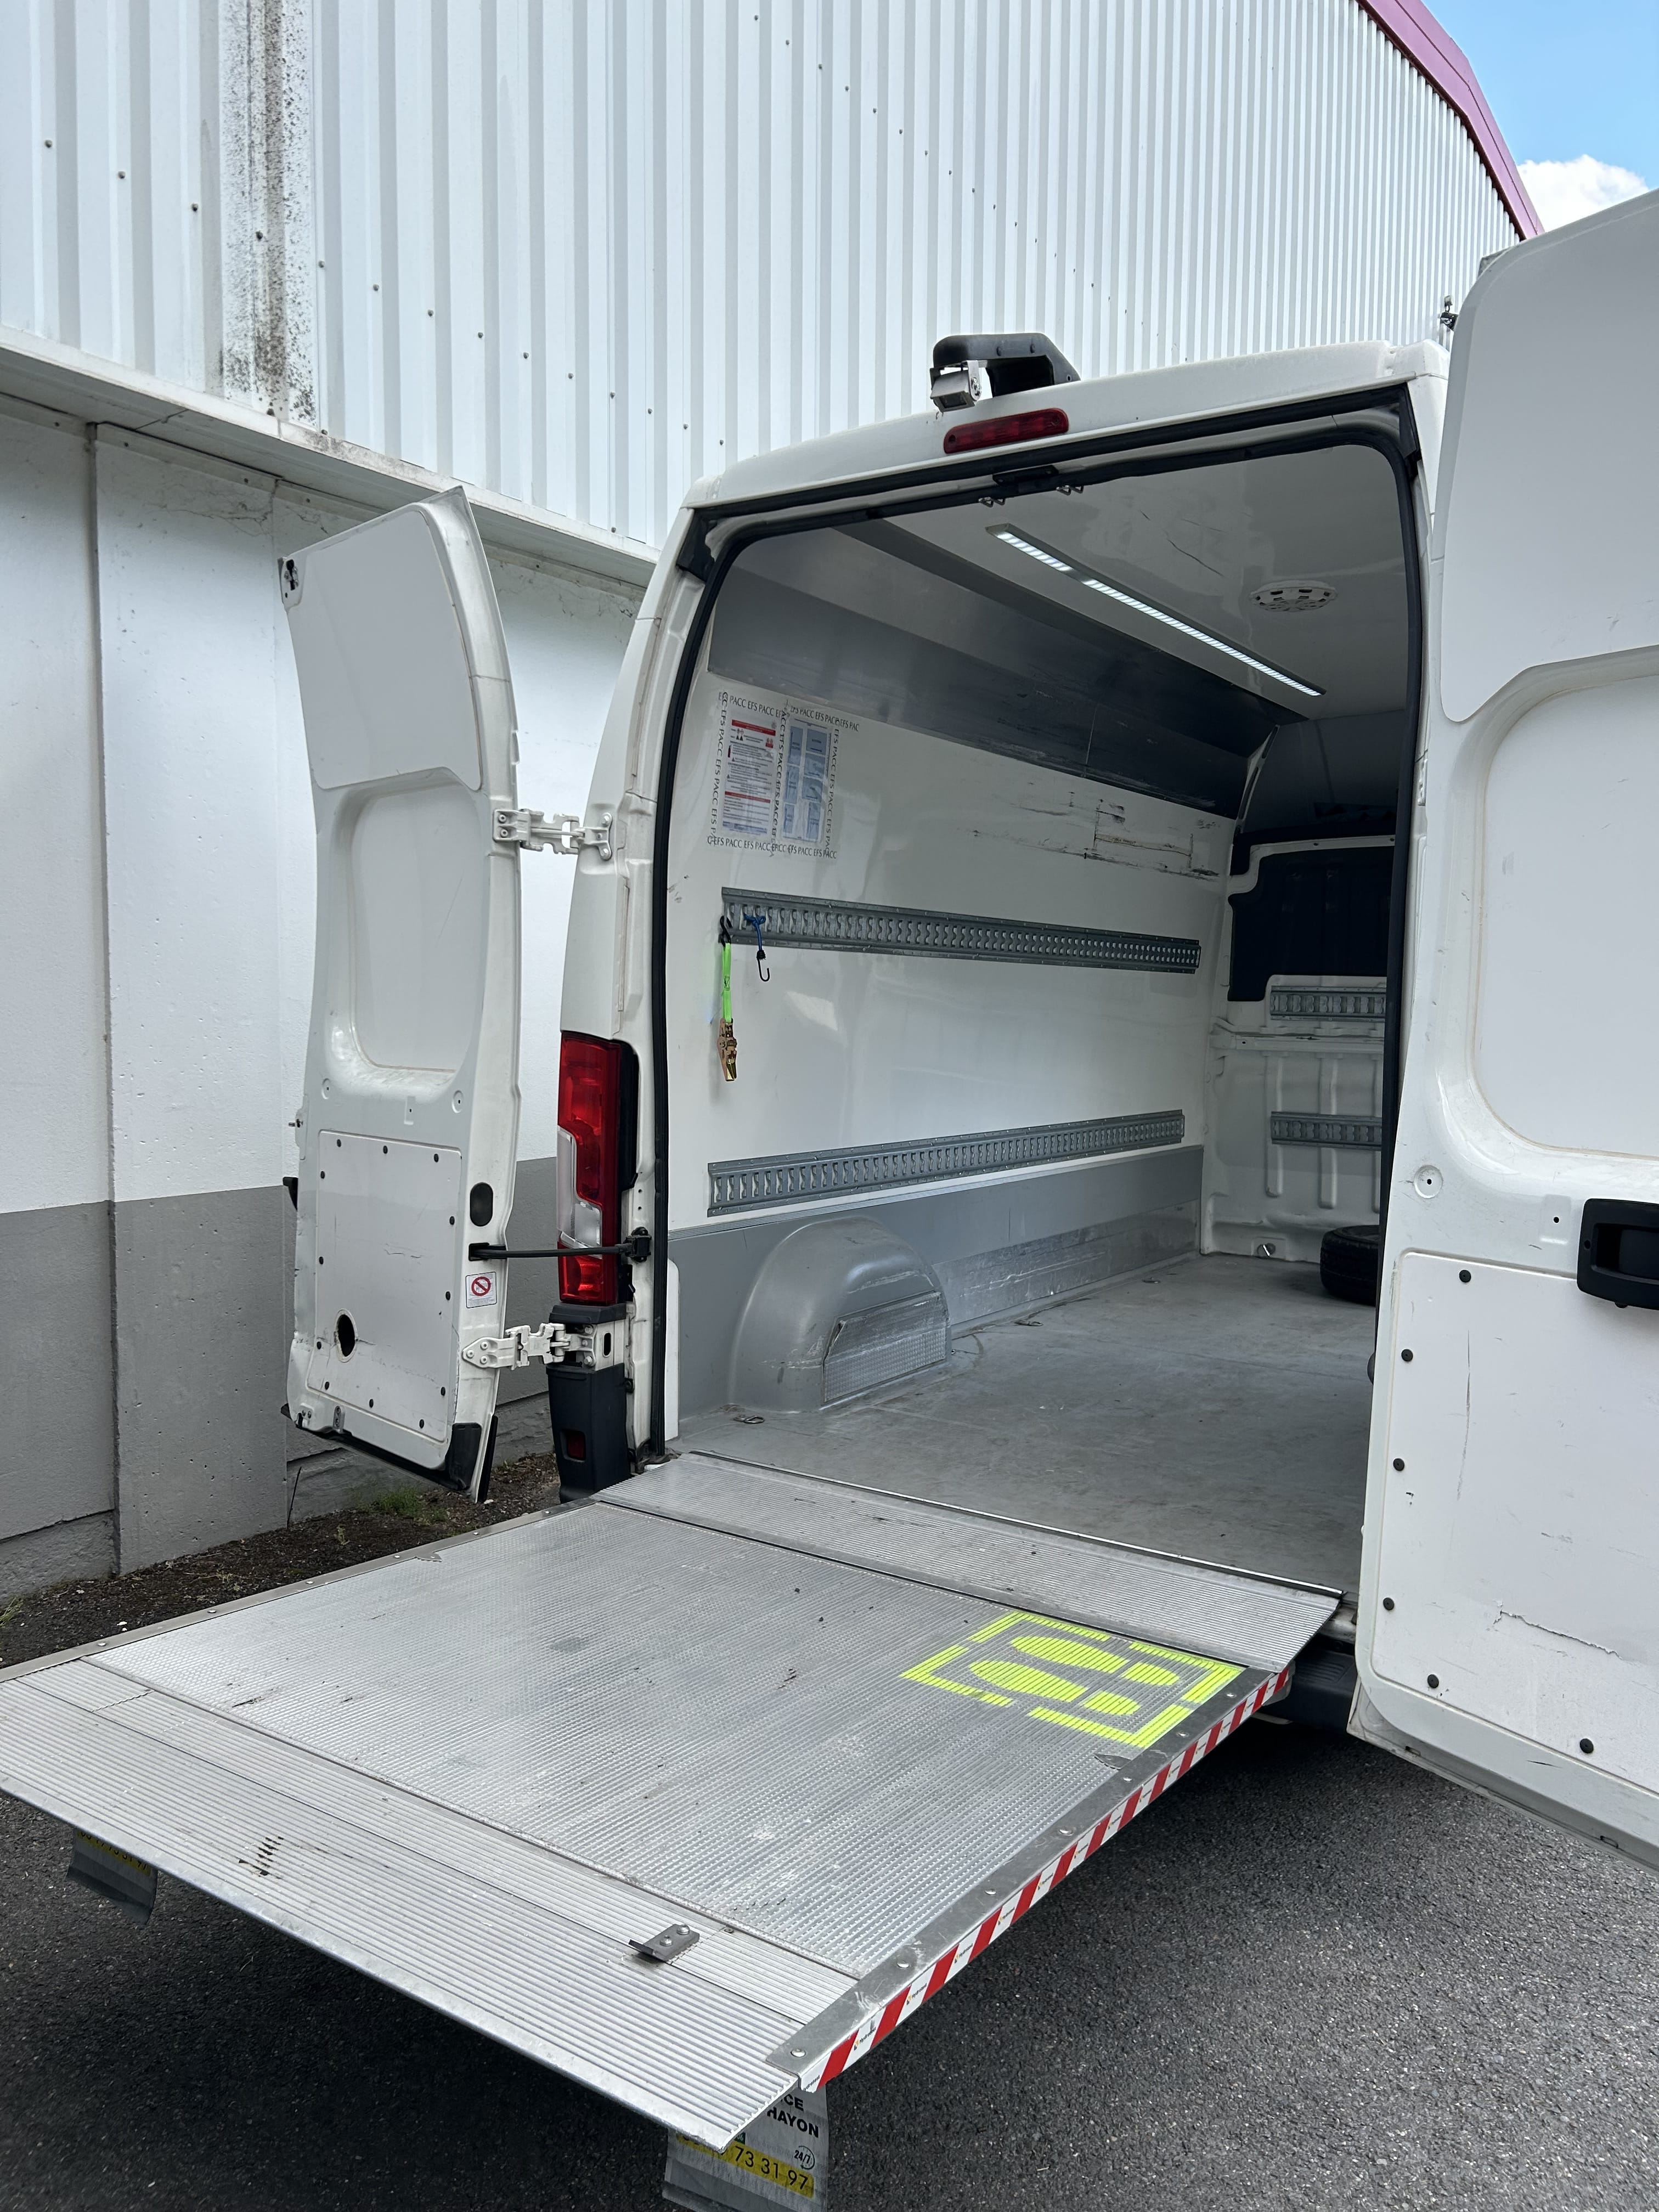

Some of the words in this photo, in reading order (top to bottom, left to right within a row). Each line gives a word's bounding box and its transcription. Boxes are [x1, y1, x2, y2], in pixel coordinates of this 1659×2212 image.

[730, 696, 746, 708] PACC
[748, 701, 757, 711] EFS
[759, 704, 774, 716] PACC
[800, 708, 814, 719] PACC
[815, 712, 824, 721] EFS
[726, 838, 742, 848] PACC
[744, 840, 754, 849] EFS
[755, 841, 770, 851] PACC
[798, 846, 812, 856] PACC
[814, 848, 822, 857] EFS
[781, 2094, 804, 2112] CE
[794, 2149, 811, 2164] 24/7
[735, 2146, 754, 2168] 73
[761, 2158, 779, 2179] 31
[788, 2170, 808, 2190] 97
